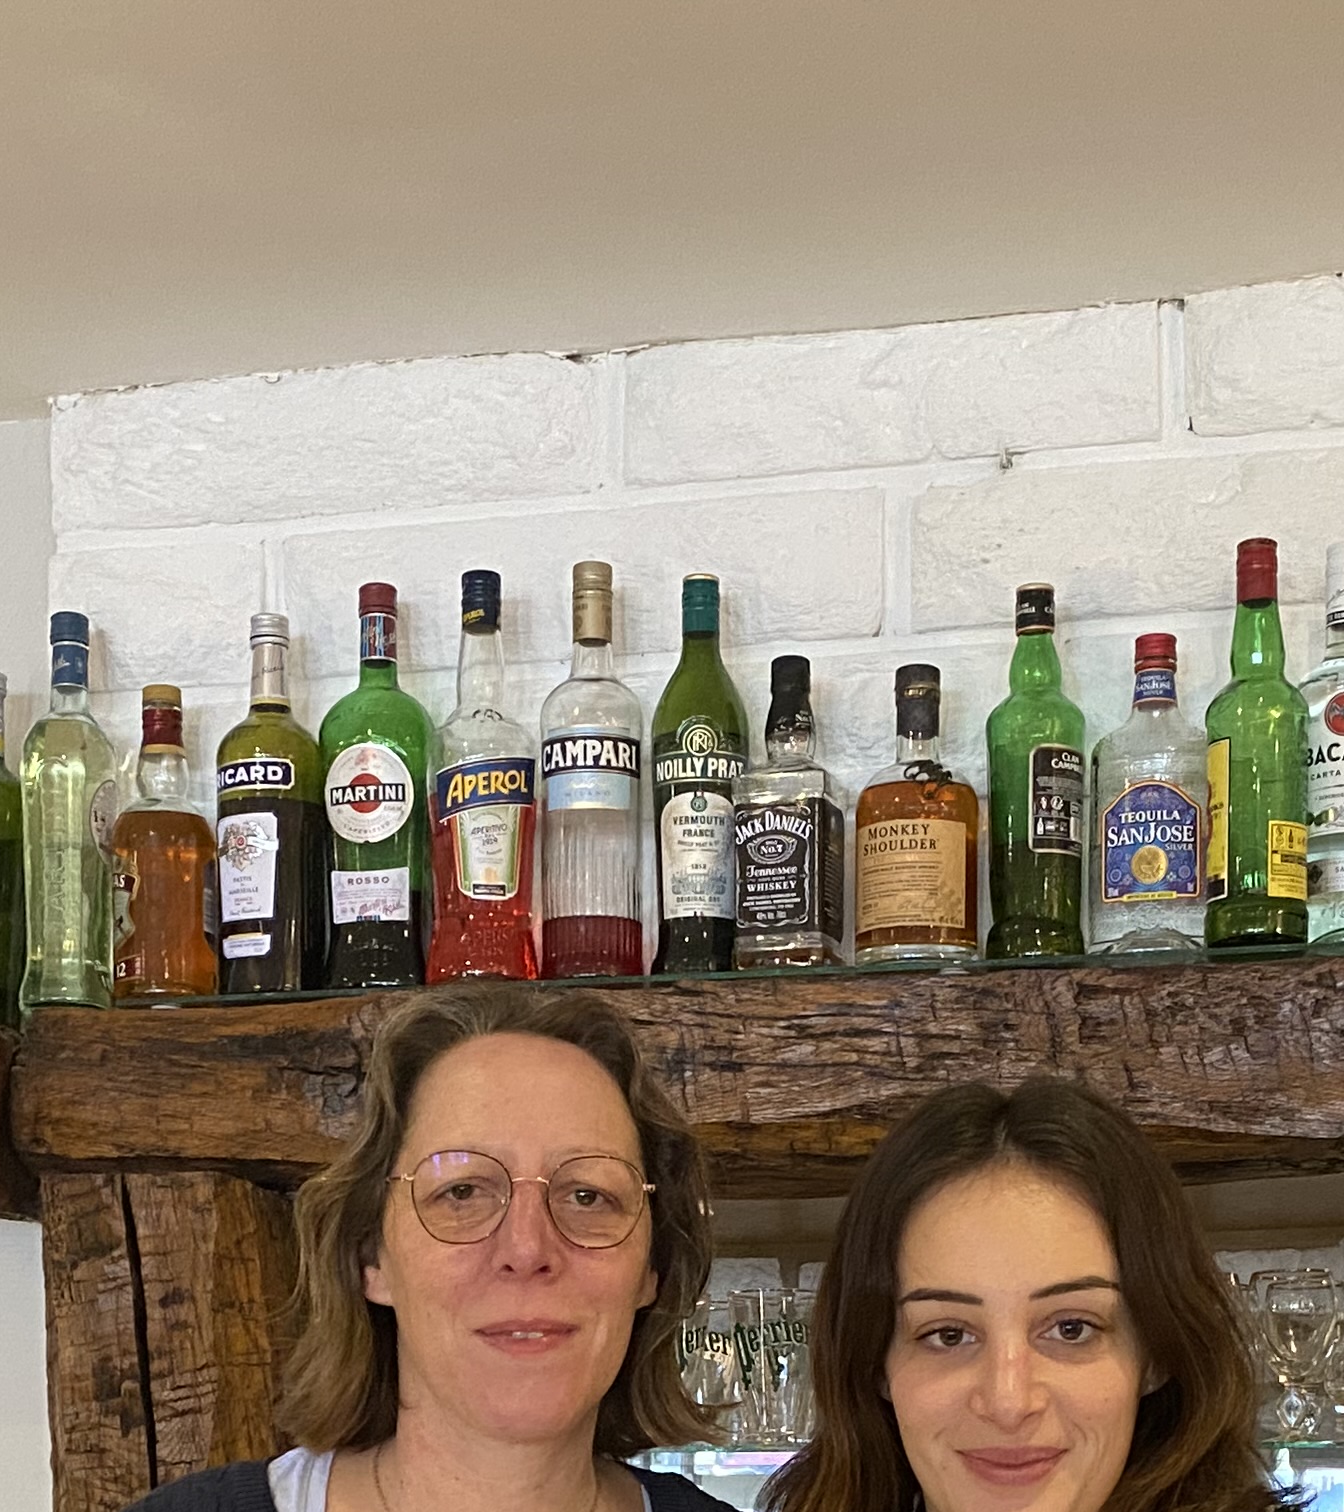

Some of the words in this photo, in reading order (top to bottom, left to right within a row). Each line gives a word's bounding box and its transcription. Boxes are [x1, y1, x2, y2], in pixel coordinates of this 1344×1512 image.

[543, 740, 639, 770] CAMPARI
[656, 757, 704, 782] NOILLY
[707, 757, 744, 779] PRAT
[1310, 768, 1342, 780] CARTA
[332, 784, 403, 805] MARTINI
[446, 769, 528, 809] APEROL
[673, 815, 726, 826] VERMOUTH
[1119, 809, 1181, 824] TEQUILA
[682, 828, 715, 838] FRANCE
[735, 816, 764, 845] JACK
[765, 810, 813, 840] DANIEL'S
[868, 823, 931, 841] MONKEY
[863, 838, 938, 857] SHOULDER
[1164, 842, 1194, 851] SILVER
[746, 865, 797, 878] Tennessee
[347, 876, 390, 886] ROSSO
[747, 881, 797, 892] WHISKEY
